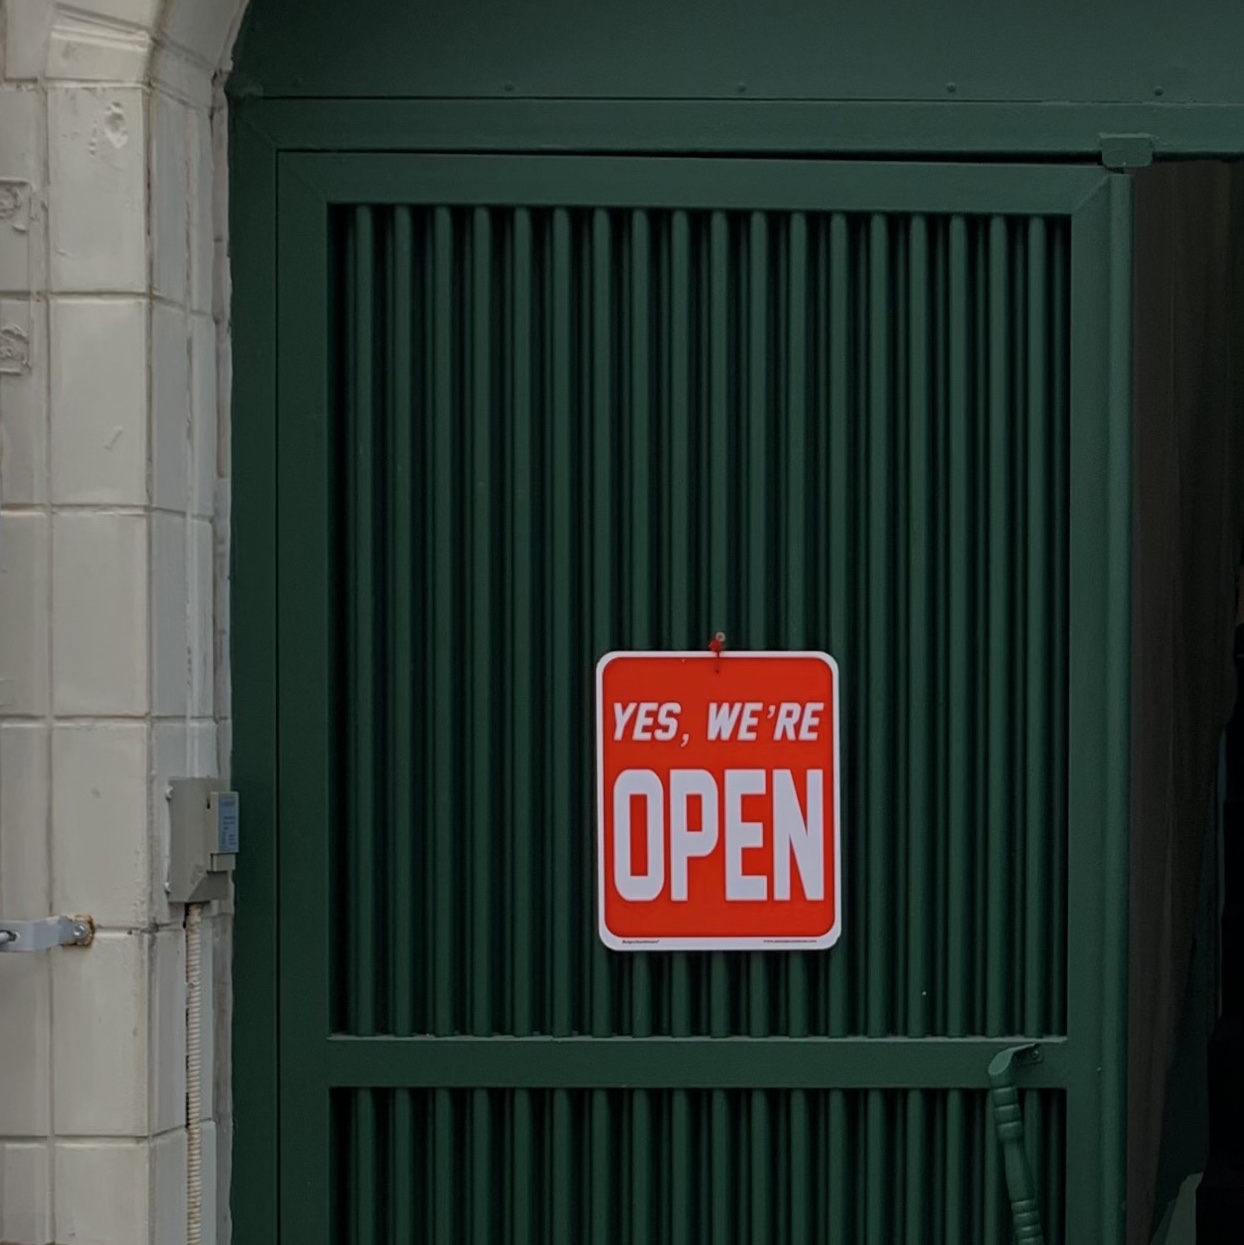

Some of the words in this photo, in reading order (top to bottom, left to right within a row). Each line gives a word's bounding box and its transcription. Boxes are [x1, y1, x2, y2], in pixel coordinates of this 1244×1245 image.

[612, 701, 690, 748] YES,
[706, 701, 825, 741] WE'RE
[612, 767, 825, 902] OPEN
